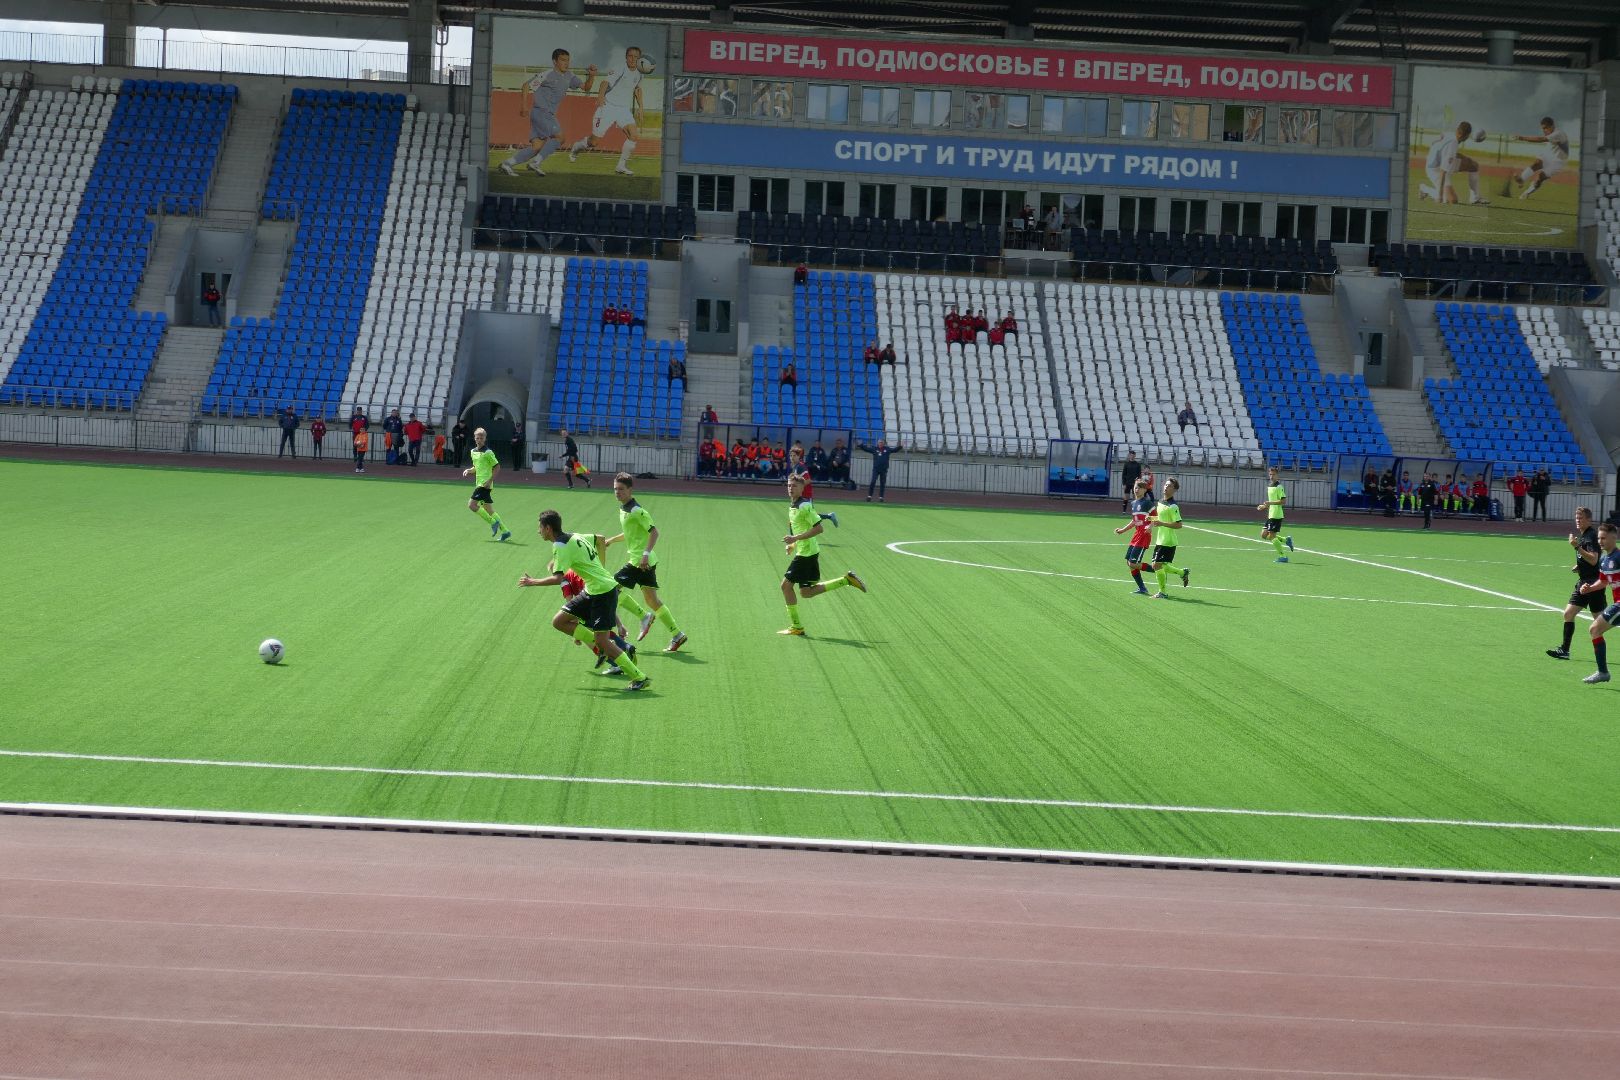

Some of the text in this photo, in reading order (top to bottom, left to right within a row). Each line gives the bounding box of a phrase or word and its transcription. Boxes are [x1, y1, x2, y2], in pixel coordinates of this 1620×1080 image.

[709, 40, 827, 70] ВПЕРЕД,
[836, 47, 1049, 77] ПОДМОСКОВЬЕ
[1073, 59, 1192, 88] ВПЕРЕД,
[1200, 66, 1354, 93] ПОДОЛЬСК
[834, 139, 928, 163] СПОРТ
[936, 145, 955, 165] И
[963, 147, 1034, 173] ТРУД
[1043, 151, 1116, 174] ИДУТ
[1124, 155, 1222, 180] РЯДОМ
